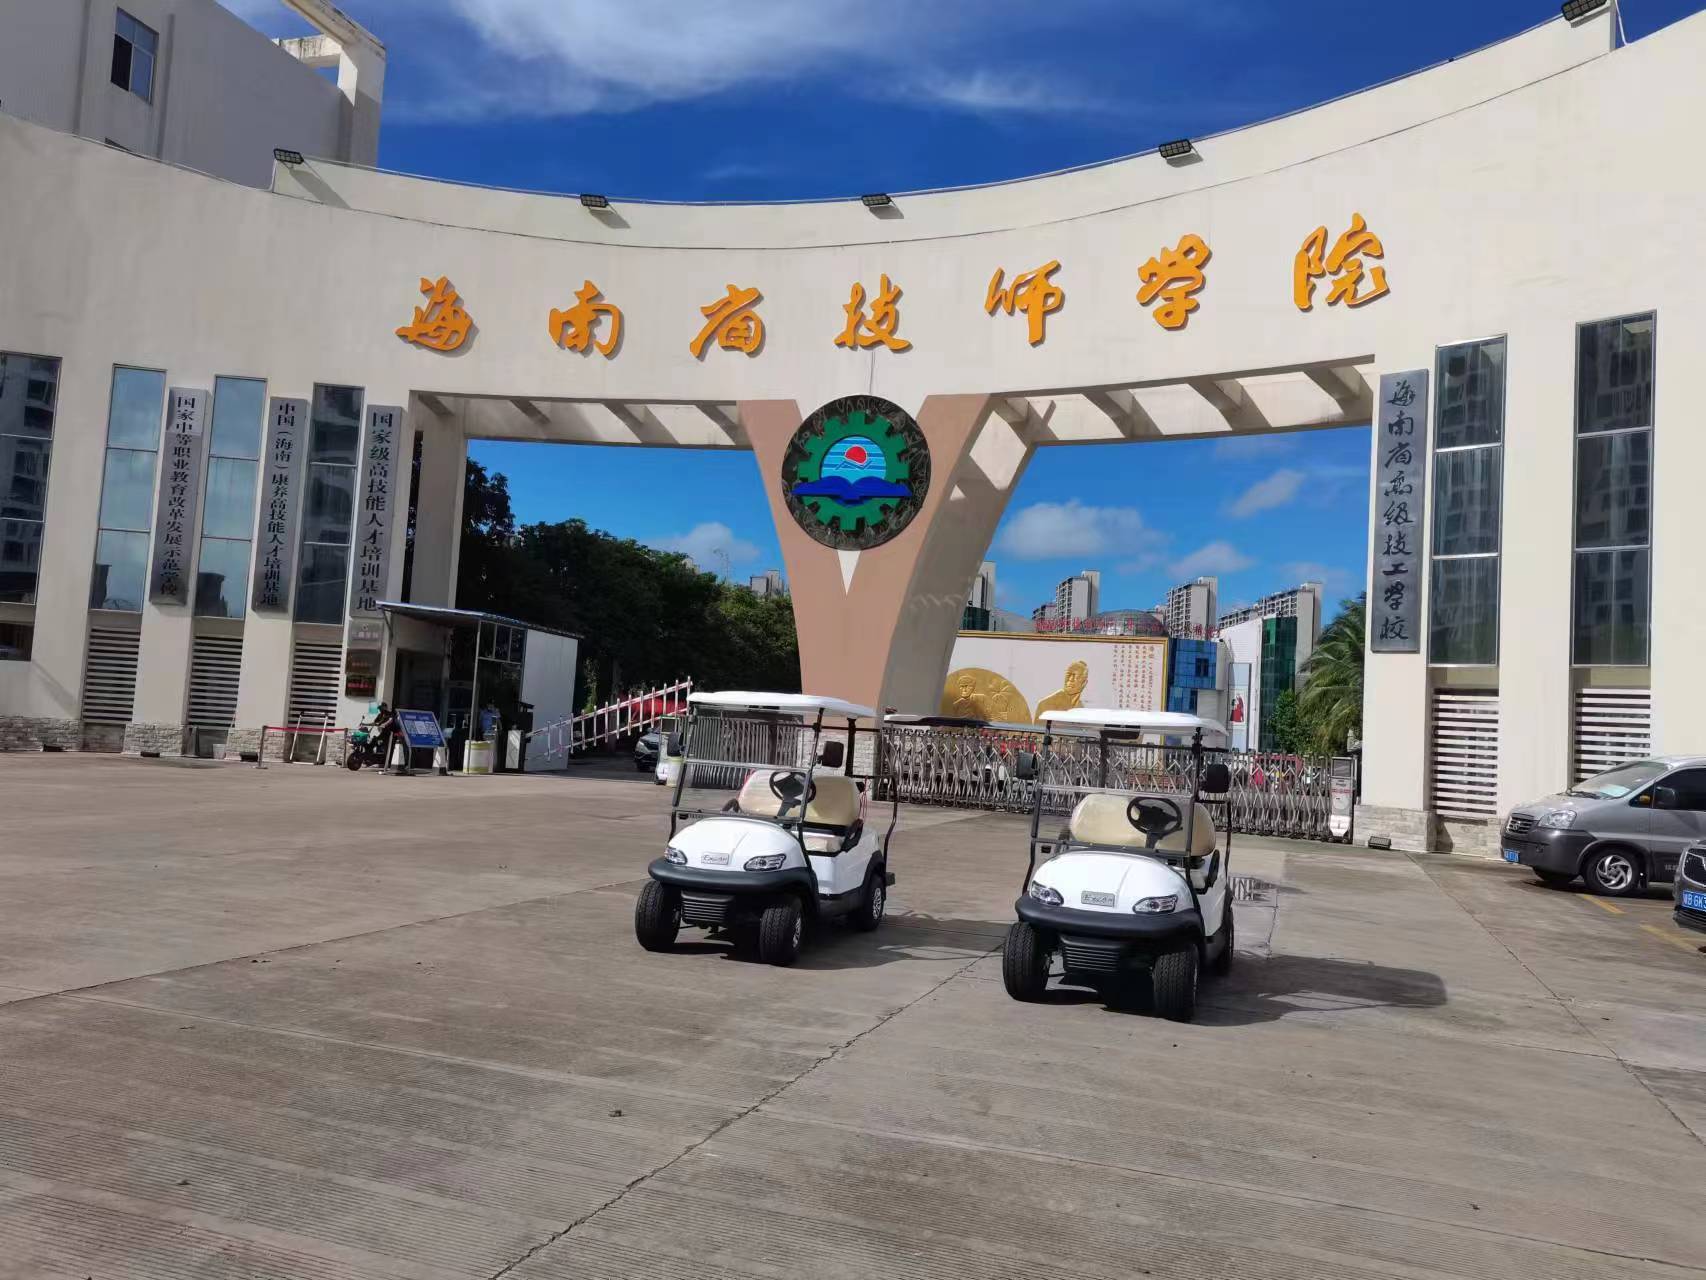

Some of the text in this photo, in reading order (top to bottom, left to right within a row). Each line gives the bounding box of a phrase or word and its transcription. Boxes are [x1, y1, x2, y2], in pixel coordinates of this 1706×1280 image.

[395, 212, 1391, 358] 海南省技师学院
[356, 411, 393, 612] 国家级高技能人才培训基地
[1379, 379, 1416, 641] 海南省高级技工学校
